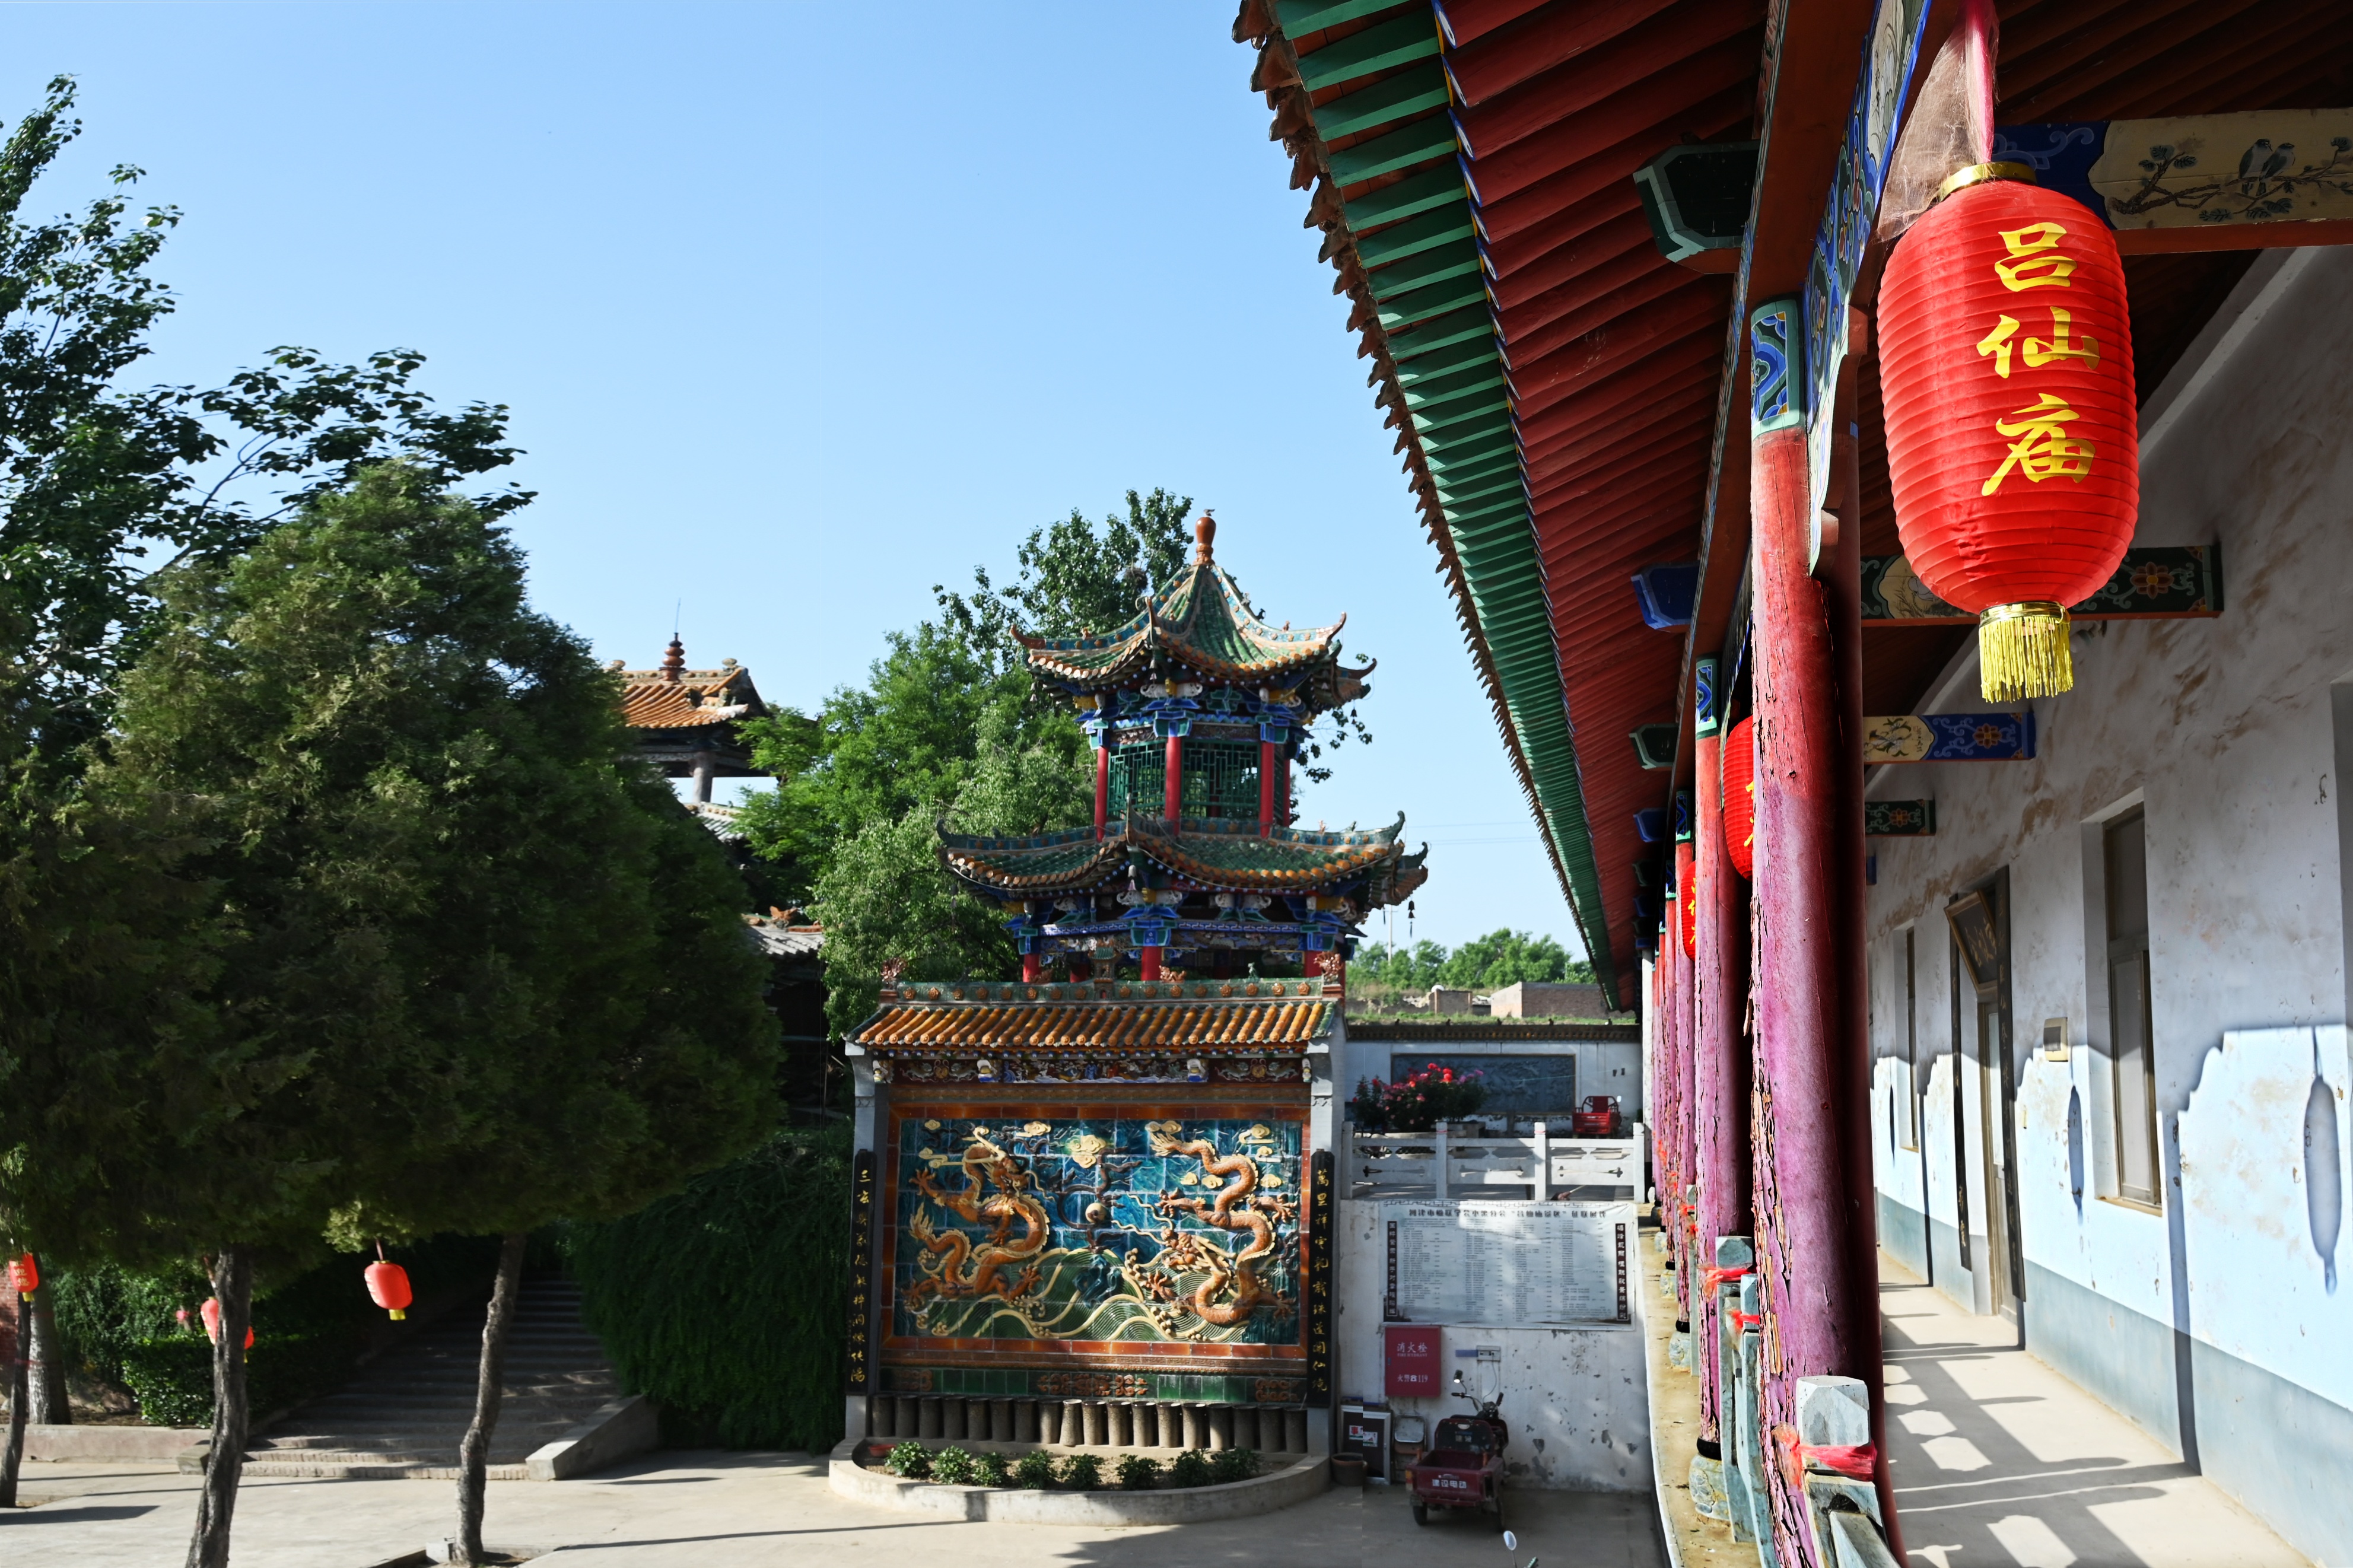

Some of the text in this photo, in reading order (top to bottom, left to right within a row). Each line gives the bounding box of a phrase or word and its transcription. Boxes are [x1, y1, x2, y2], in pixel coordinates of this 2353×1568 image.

[1976, 222, 2101, 497] 吕仙庙
[1397, 1342, 1427, 1353] 消火栓
